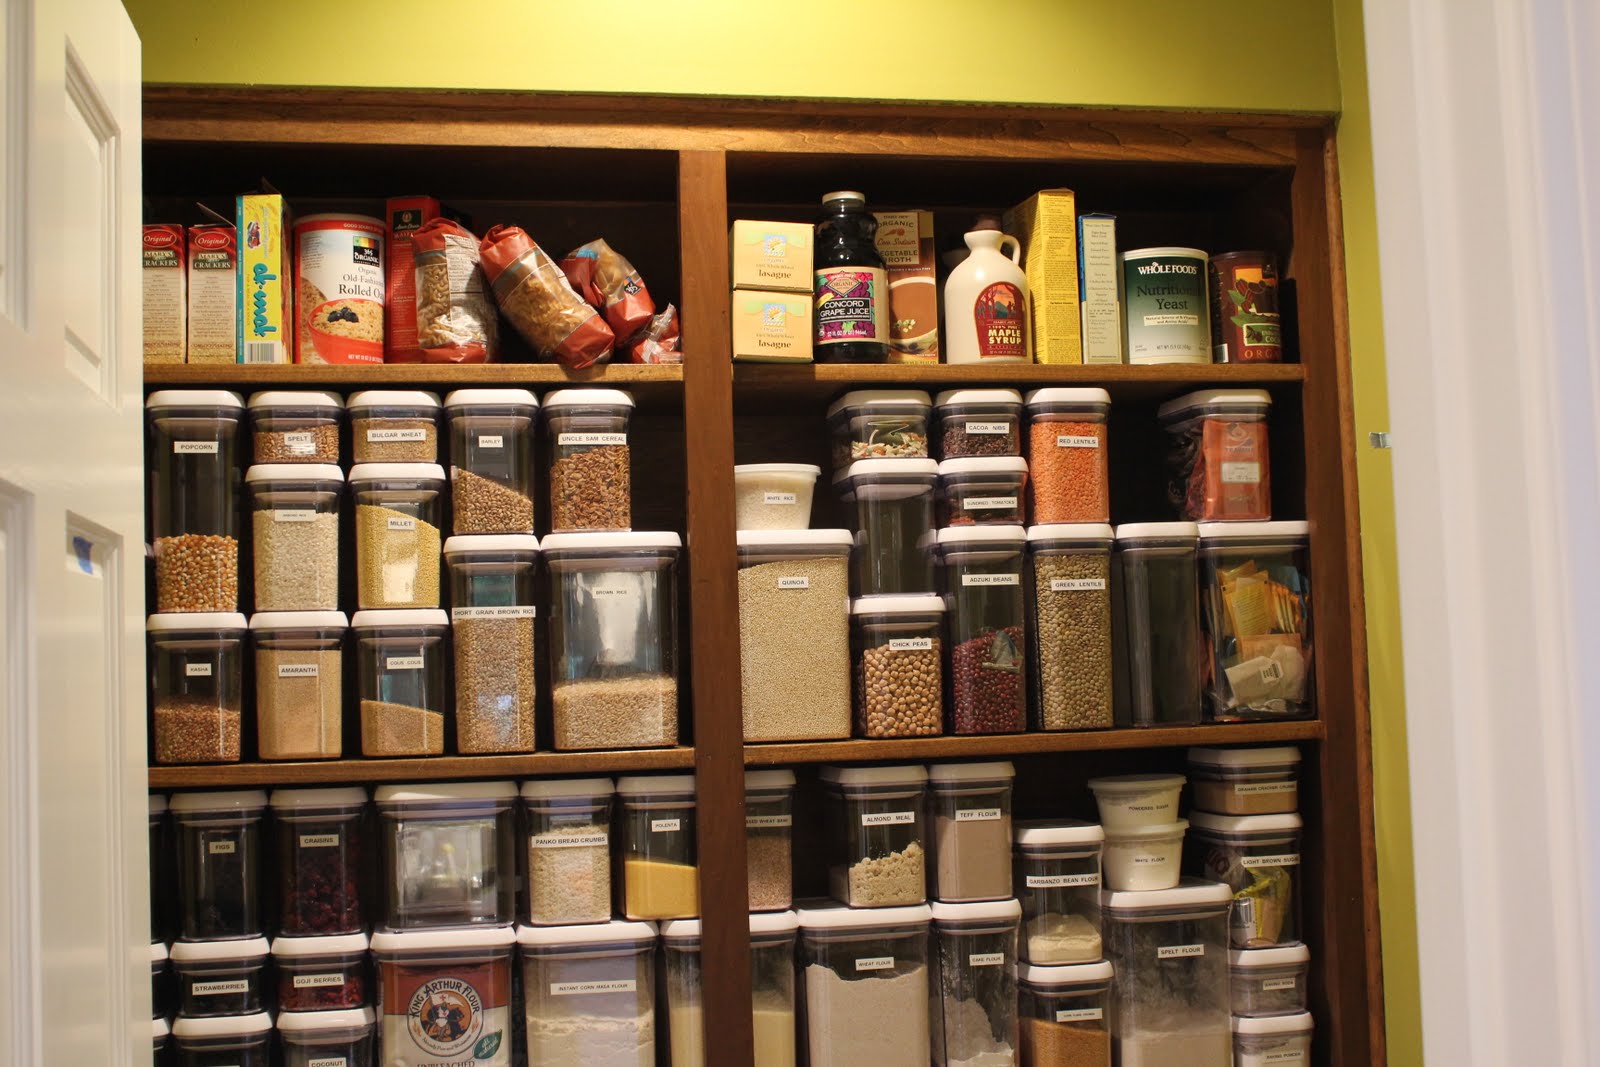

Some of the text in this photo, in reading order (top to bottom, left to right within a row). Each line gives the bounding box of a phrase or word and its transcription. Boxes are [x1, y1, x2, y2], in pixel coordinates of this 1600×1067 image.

[878, 220, 914, 228] ORGANIC
[144, 234, 174, 245] Original
[197, 237, 227, 247] Original
[194, 261, 231, 269] CRACKERS
[358, 265, 377, 275] Organic
[1137, 263, 1197, 275] WHOLE FOODS
[758, 269, 792, 280] lasagne
[338, 284, 372, 297] Rolled
[824, 300, 865, 309] CONCORD
[1155, 298, 1188, 310] Yeast
[819, 308, 846, 318] GRAPE
[988, 329, 1021, 337] MAPLE
[758, 339, 792, 349] lasagne
[988, 336, 1022, 345] SYRUP
[371, 431, 398, 439] BULGAR
[1073, 438, 1097, 446] LENTILS
[1078, 580, 1102, 588] LENTILS
[866, 815, 892, 823] ALMOND
[303, 837, 334, 845] CRAISINS
[535, 836, 606, 846] PANKO BREAD CRUMBS
[1029, 878, 1061, 886] GARBANZO
[295, 976, 342, 986] GOJI BERRIES
[194, 982, 246, 993] STRAWBERRIES
[409, 980, 480, 1018] KING ARTHUR FLOUR
